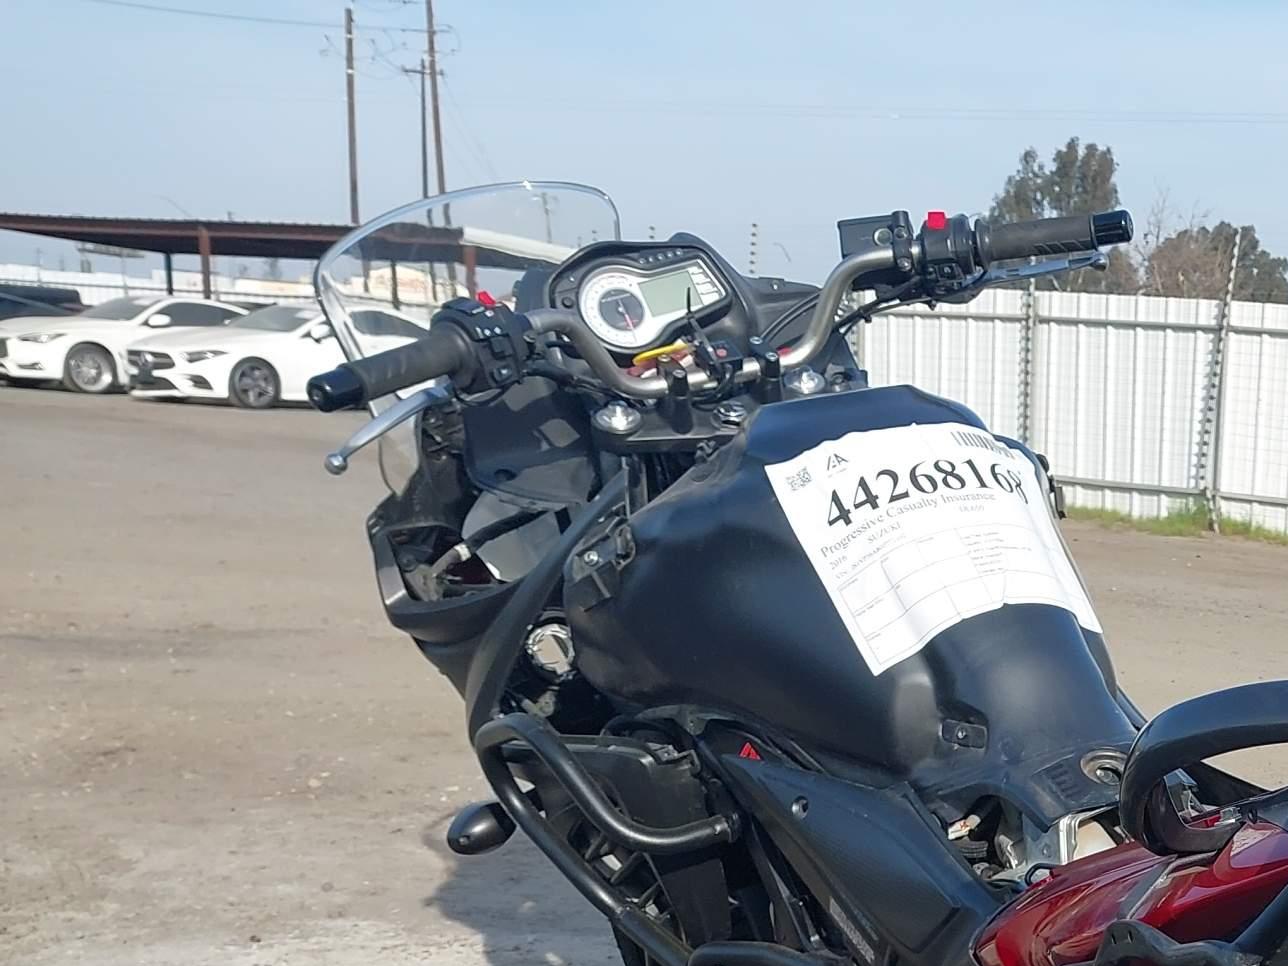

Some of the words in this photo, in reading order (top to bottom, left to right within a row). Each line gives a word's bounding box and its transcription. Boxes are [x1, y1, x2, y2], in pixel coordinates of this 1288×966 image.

[820, 514, 885, 558] Progressive
[886, 496, 938, 518] Casualty
[940, 491, 997, 504] Insurance
[826, 458, 1029, 527] 44268168
